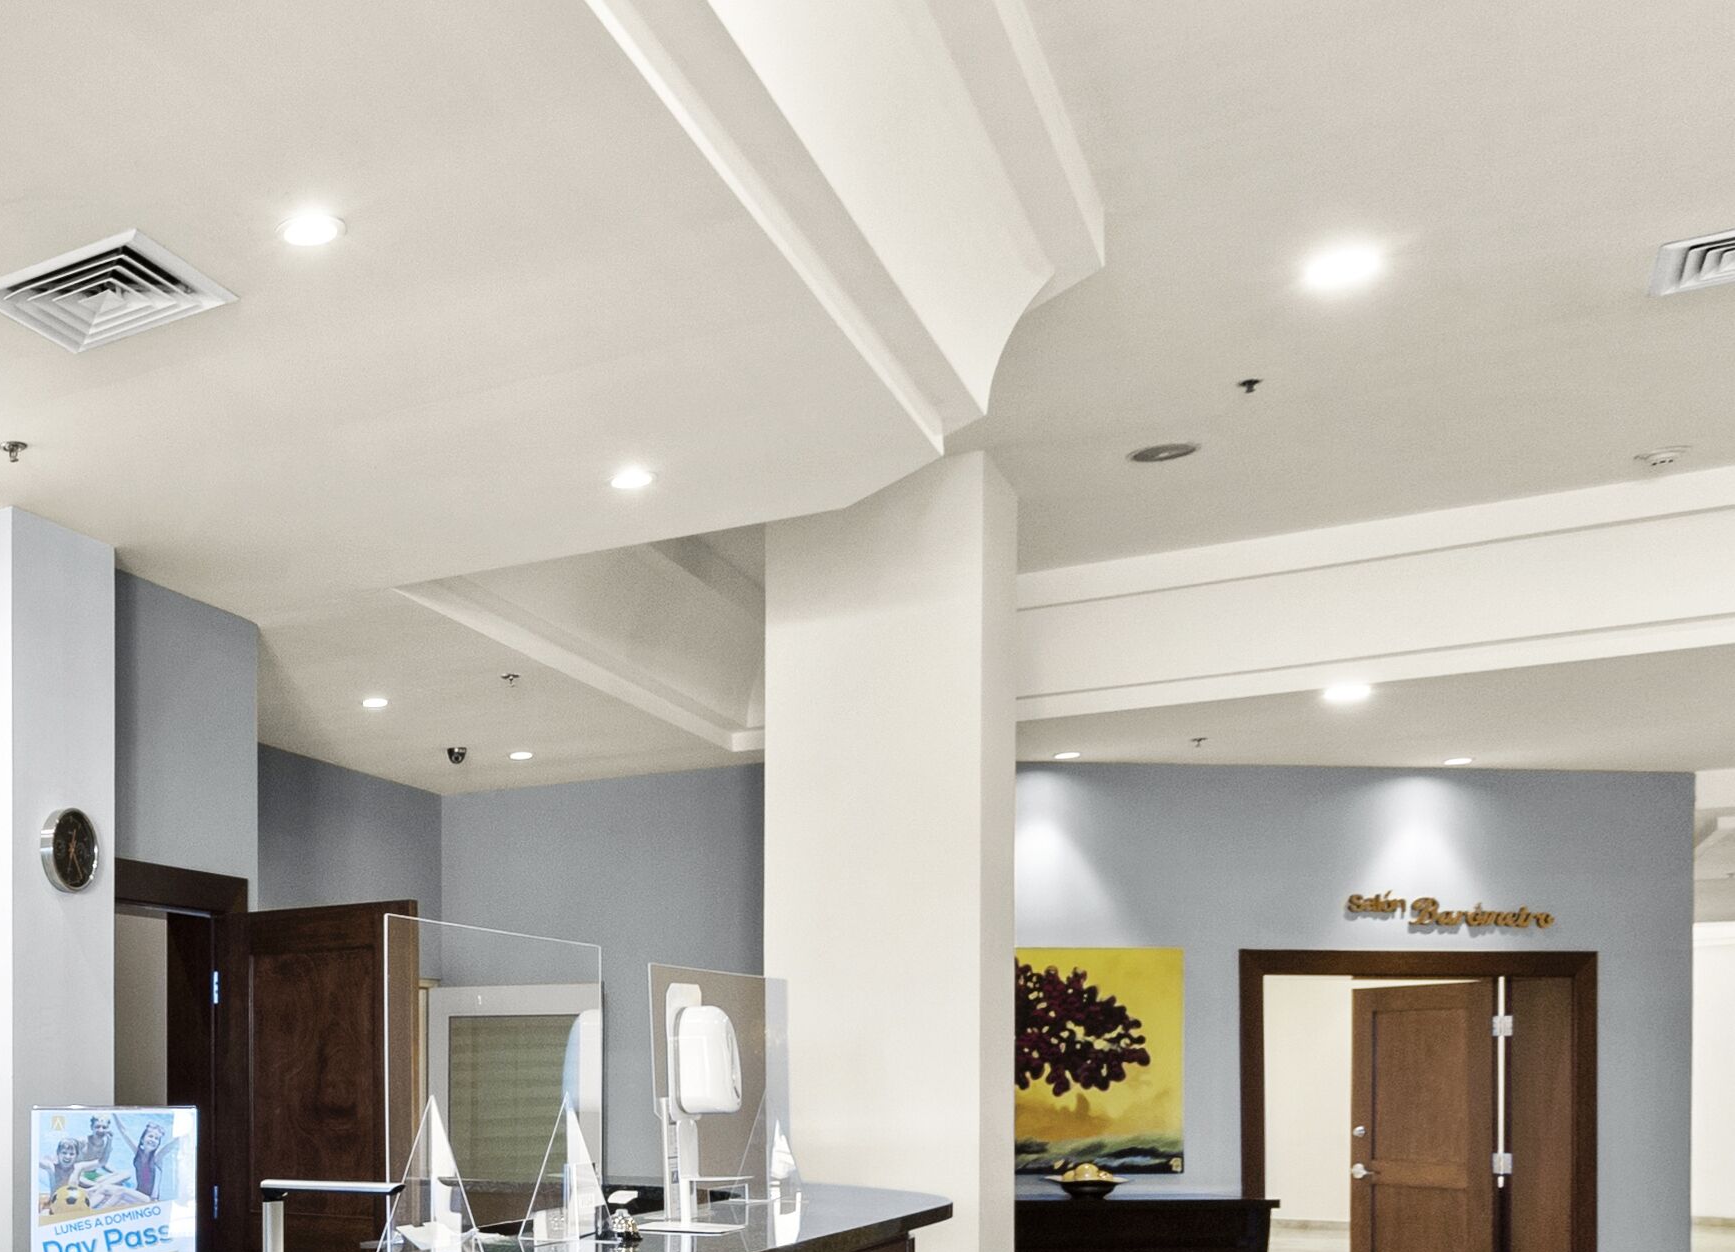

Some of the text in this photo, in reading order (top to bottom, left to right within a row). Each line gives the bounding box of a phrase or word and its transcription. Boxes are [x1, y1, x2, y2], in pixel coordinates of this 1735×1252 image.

[54, 1206, 162, 1235] LUNES A DOMINGO
